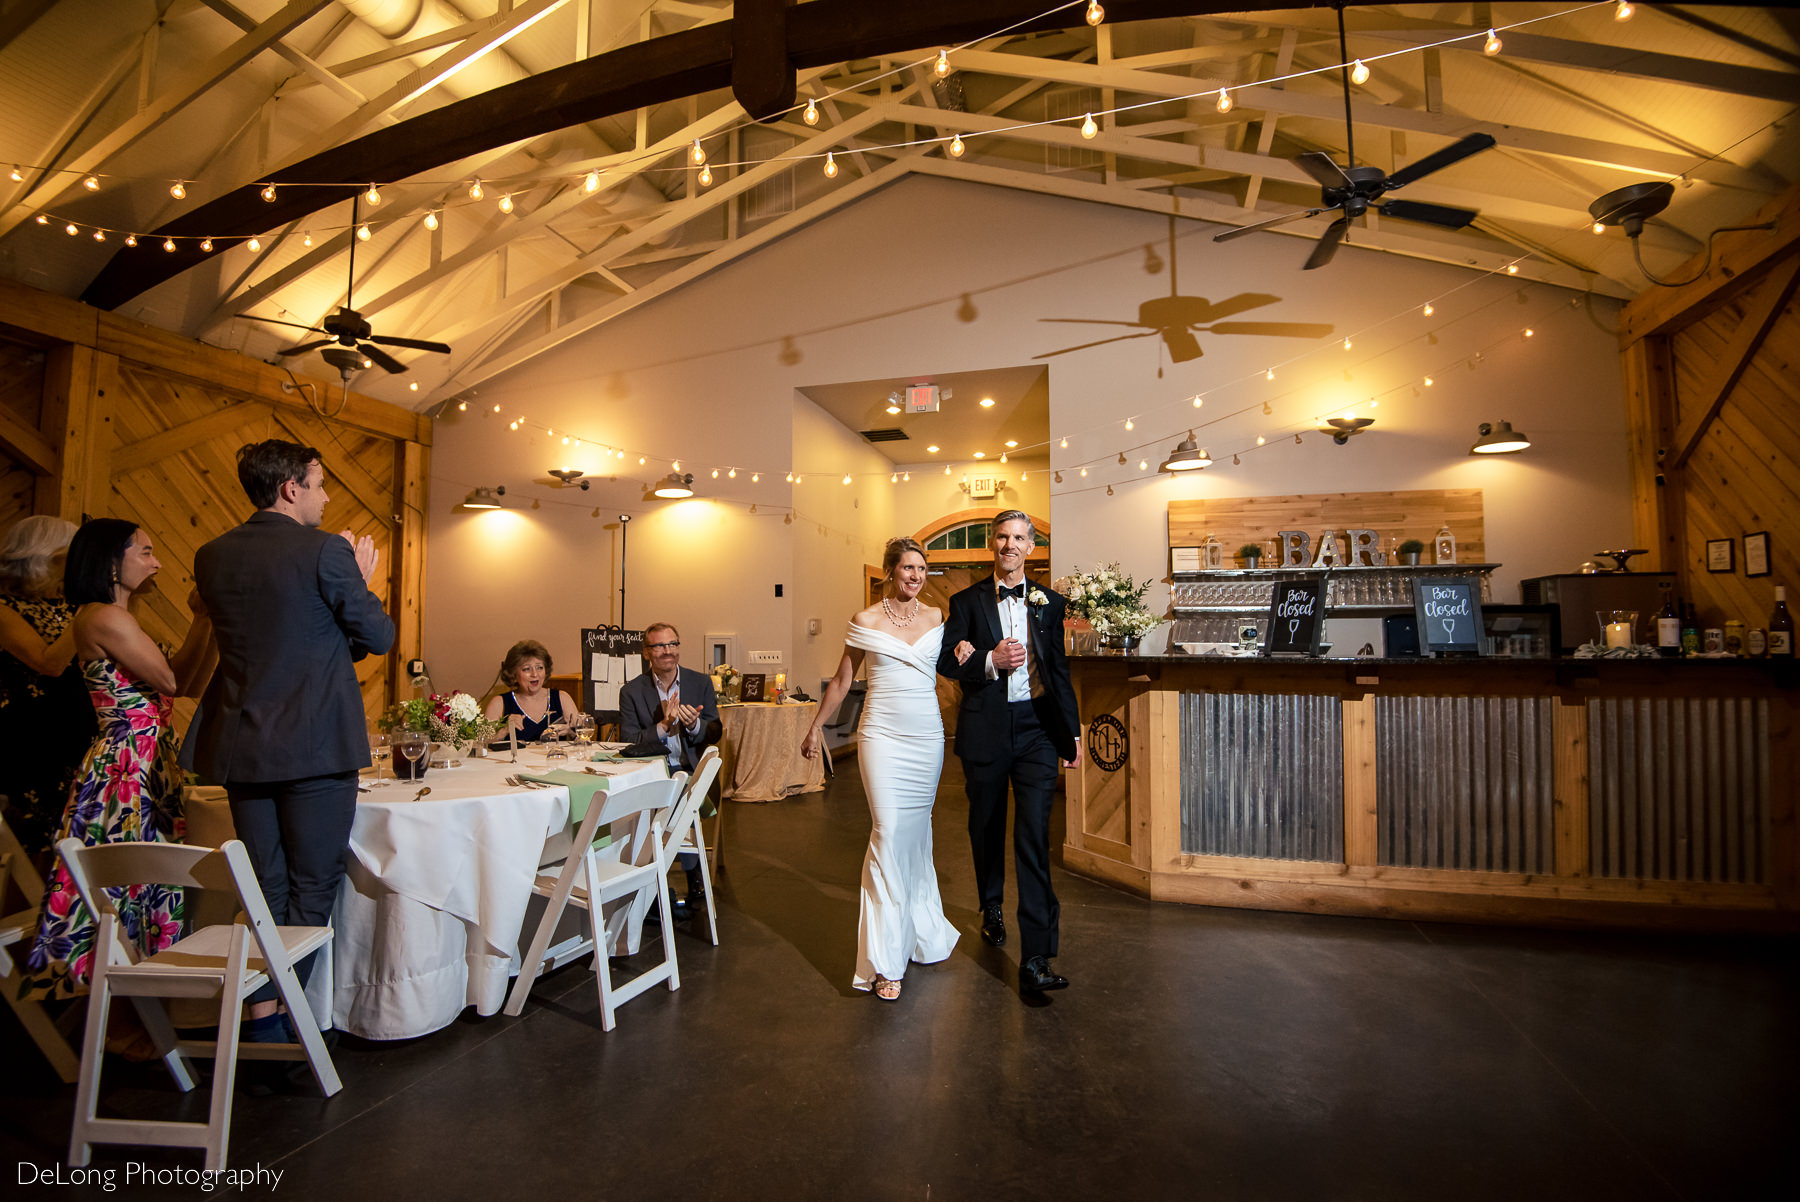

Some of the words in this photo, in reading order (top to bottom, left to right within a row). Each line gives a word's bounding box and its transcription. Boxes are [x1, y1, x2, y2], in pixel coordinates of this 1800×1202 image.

[912, 388, 933, 406] EXIT
[975, 479, 990, 491] EXIT
[1278, 529, 1386, 568] BAR
[1288, 589, 1309, 602] Bar
[1432, 586, 1458, 600] Bar
[1277, 601, 1314, 618] Closed
[1424, 599, 1469, 617] Closed
[586, 631, 607, 648] find
[608, 633, 626, 648] your
[626, 632, 644, 644] seat
